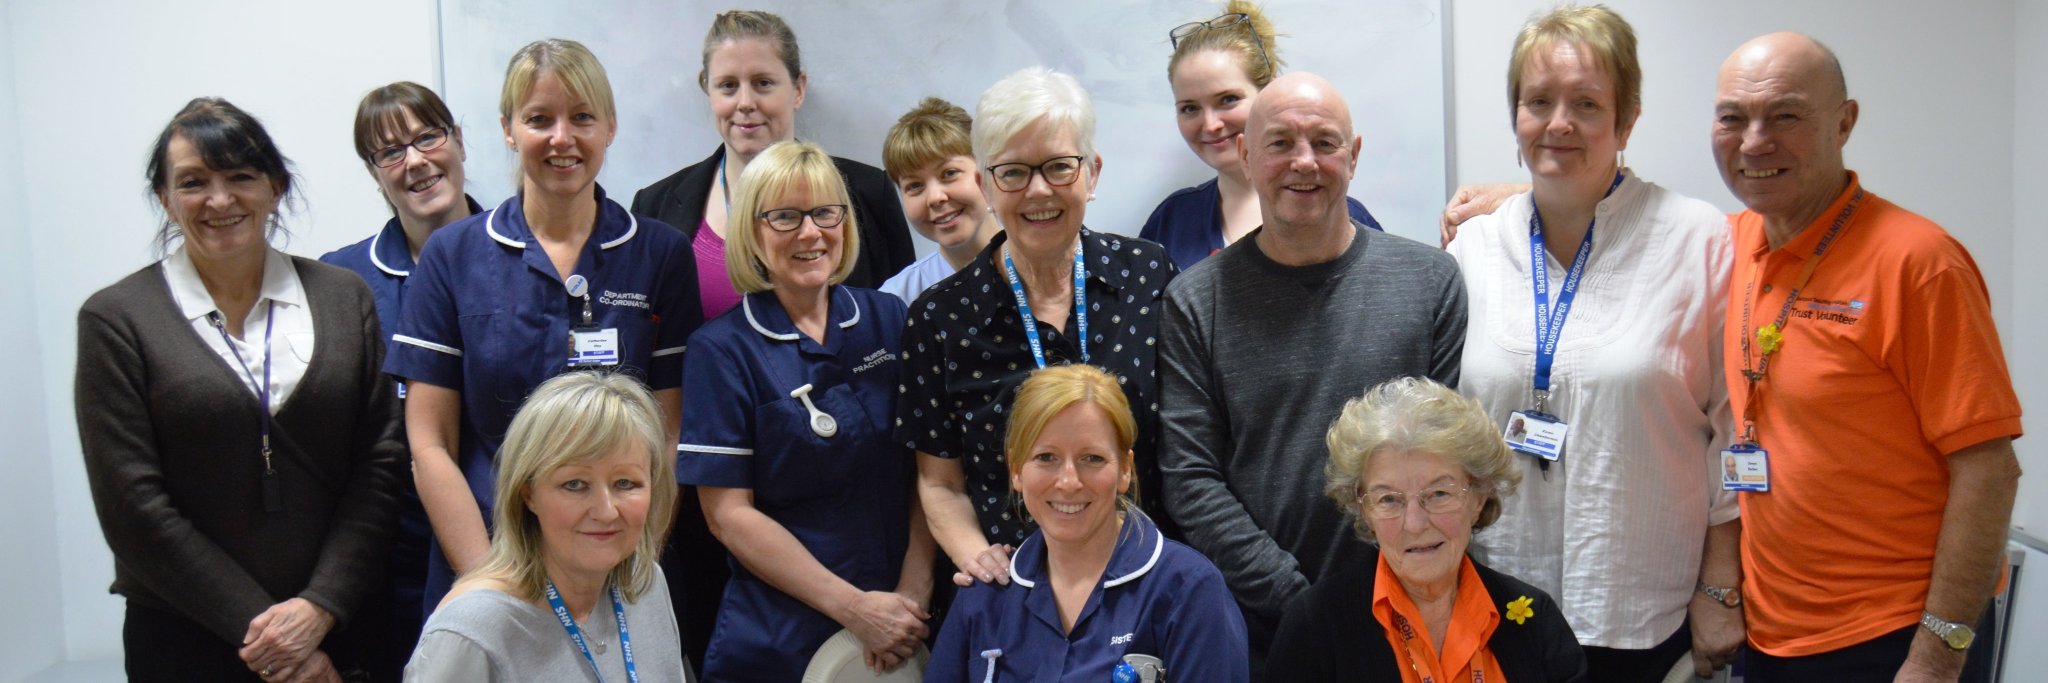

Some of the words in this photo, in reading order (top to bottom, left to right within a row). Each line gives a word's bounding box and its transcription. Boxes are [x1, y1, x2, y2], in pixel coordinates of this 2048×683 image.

[1007, 266, 1018, 284] NHS
[1076, 261, 1084, 279] NHS
[1534, 243, 1546, 294] HOUSEKEEPER
[599, 297, 650, 310] CO-ORDINATOR
[1014, 289, 1027, 307] NHS
[1075, 286, 1084, 305] NHS
[1544, 302, 1568, 355] HOUSEKEEPER
[1565, 241, 1590, 293] HOUSEKEEPER
[1773, 287, 1799, 326] HOSPIT
[1790, 307, 1813, 319] Trust
[1022, 313, 1035, 332] NHS
[1077, 312, 1085, 332] NHS
[1538, 303, 1548, 343] HOUSEKEE
[863, 348, 887, 362] NURSE
[1030, 338, 1042, 358] NHS
[852, 353, 897, 374] PRACTITIO
[555, 605, 573, 627] NHS
[570, 632, 586, 654] NHS
[617, 611, 628, 633] NHS
[623, 641, 633, 663] NHS
[629, 670, 639, 683] NH
[1110, 632, 1133, 646] SISTE
